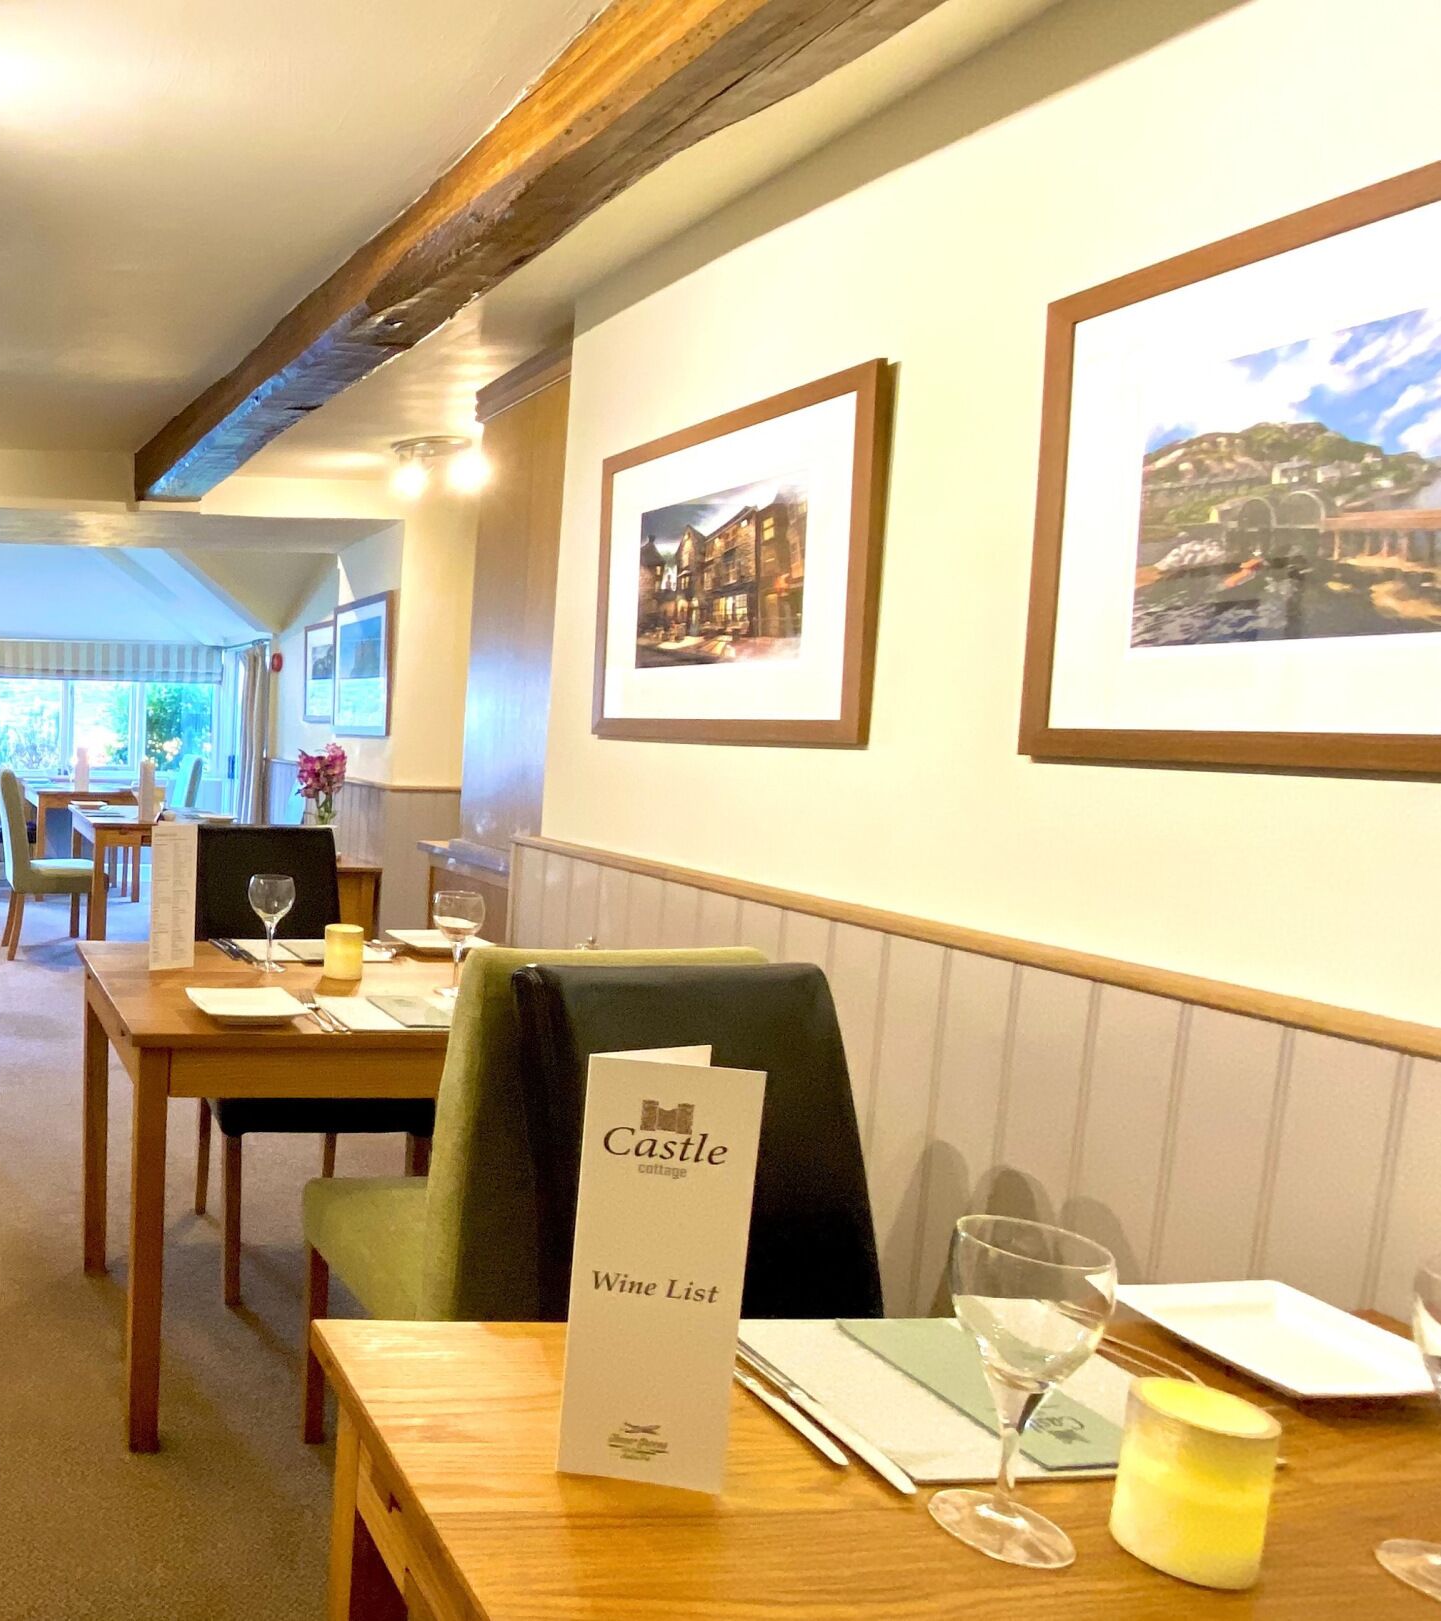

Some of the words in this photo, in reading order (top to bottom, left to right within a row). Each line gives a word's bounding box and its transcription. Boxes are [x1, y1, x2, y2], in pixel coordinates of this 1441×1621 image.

[603, 1126, 728, 1166] Castle
[638, 1163, 687, 1180] cottage
[592, 1270, 658, 1296] Wine
[666, 1278, 719, 1304] List
